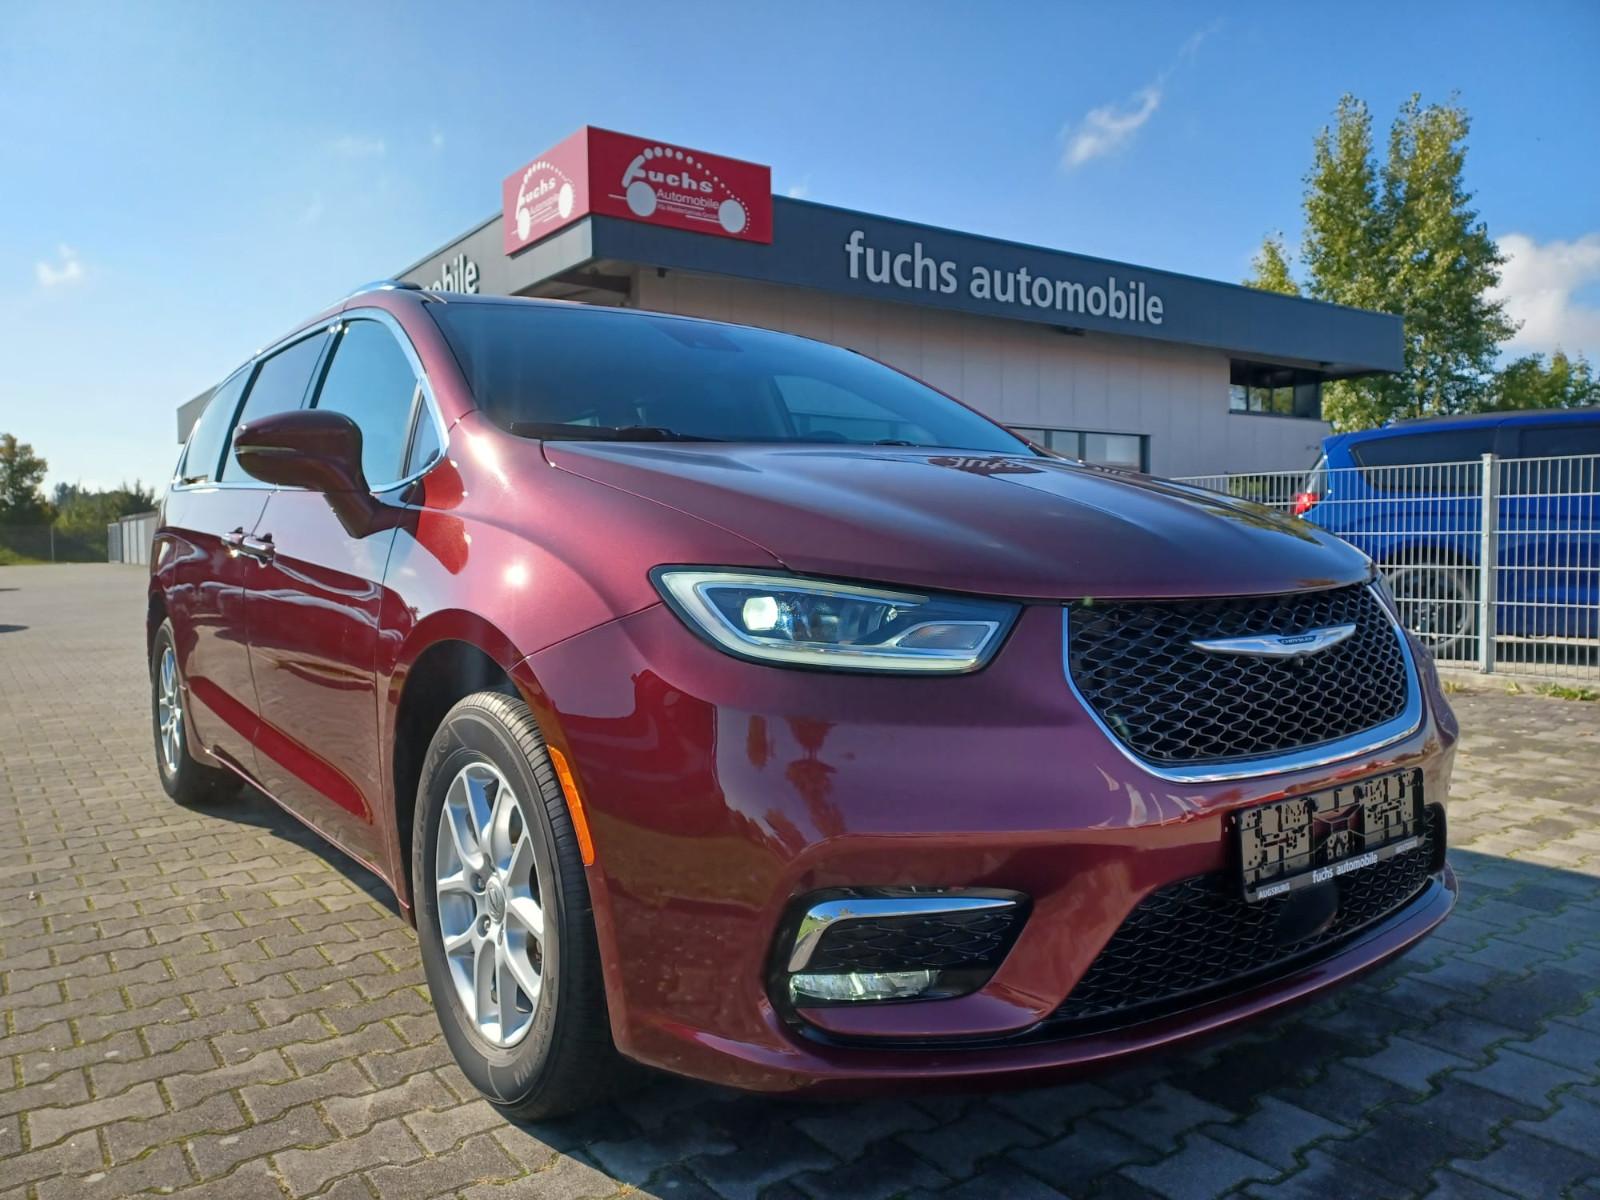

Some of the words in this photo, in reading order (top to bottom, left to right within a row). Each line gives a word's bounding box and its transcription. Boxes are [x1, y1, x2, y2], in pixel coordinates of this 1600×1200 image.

[656, 188, 720, 210] Automobile
[845, 230, 958, 293] fuchs
[969, 266, 1164, 325] automobile
[1312, 866, 1334, 884] fuchs
[1336, 851, 1378, 876] automobile
